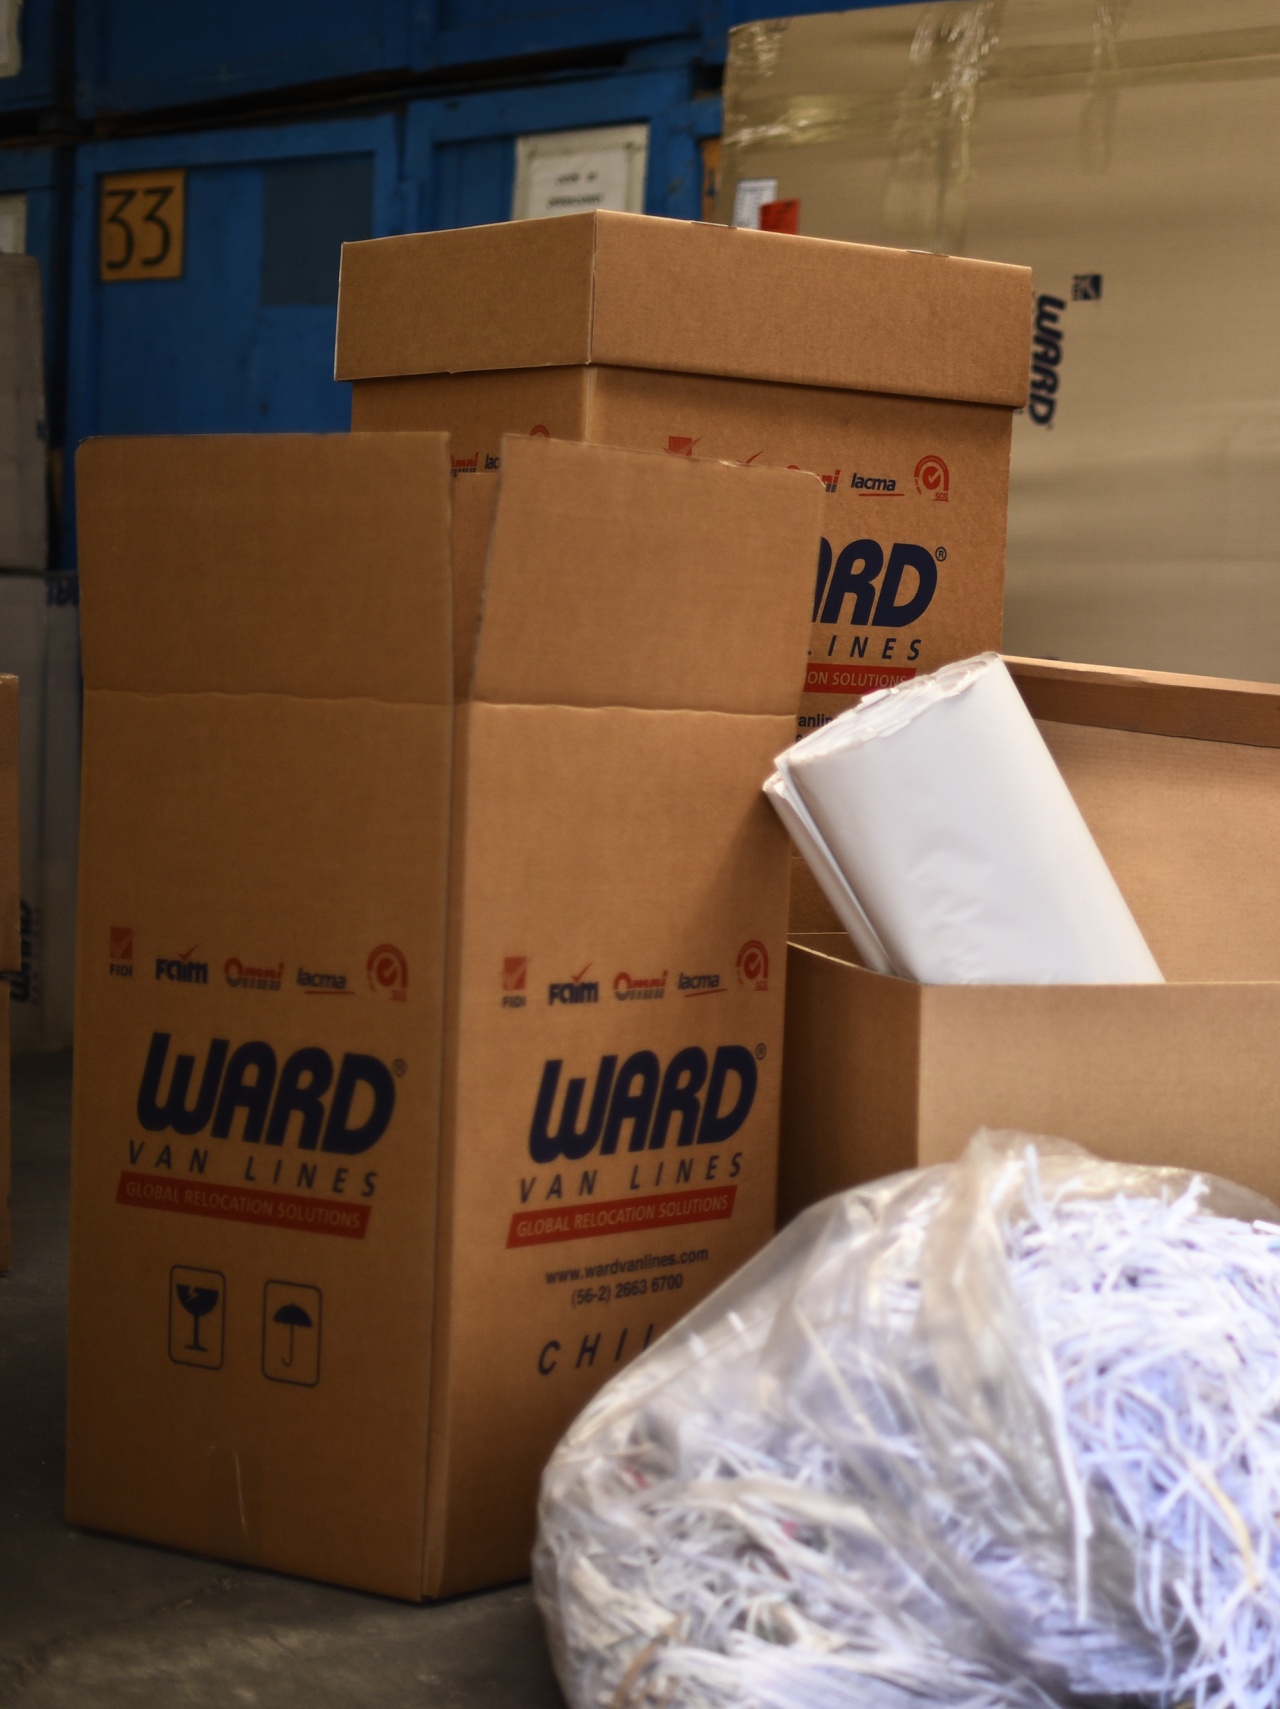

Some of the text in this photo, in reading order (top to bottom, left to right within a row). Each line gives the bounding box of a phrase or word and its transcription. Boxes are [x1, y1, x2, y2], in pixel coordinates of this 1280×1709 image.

[106, 185, 174, 270] 33
[851, 473, 896, 492] lacma
[808, 634, 922, 661] INES
[109, 963, 133, 977] FIDI
[296, 967, 347, 990] lacma
[502, 994, 527, 1010] FIDI
[678, 971, 720, 991] lacma
[137, 1032, 396, 1156] WARD
[528, 1044, 759, 1165] WARD
[128, 1140, 379, 1198] VAN LINES
[519, 1151, 744, 1204] VAN LINES
[125, 1181, 361, 1230] GLOBAL RELOCATION SOLUTIONS
[516, 1193, 730, 1239] GLOBAL RELOCATION SOLUTIONS
[546, 1247, 709, 1286] www.wardvanlines.com
[571, 1273, 684, 1308] (56-2) 2663 6700
